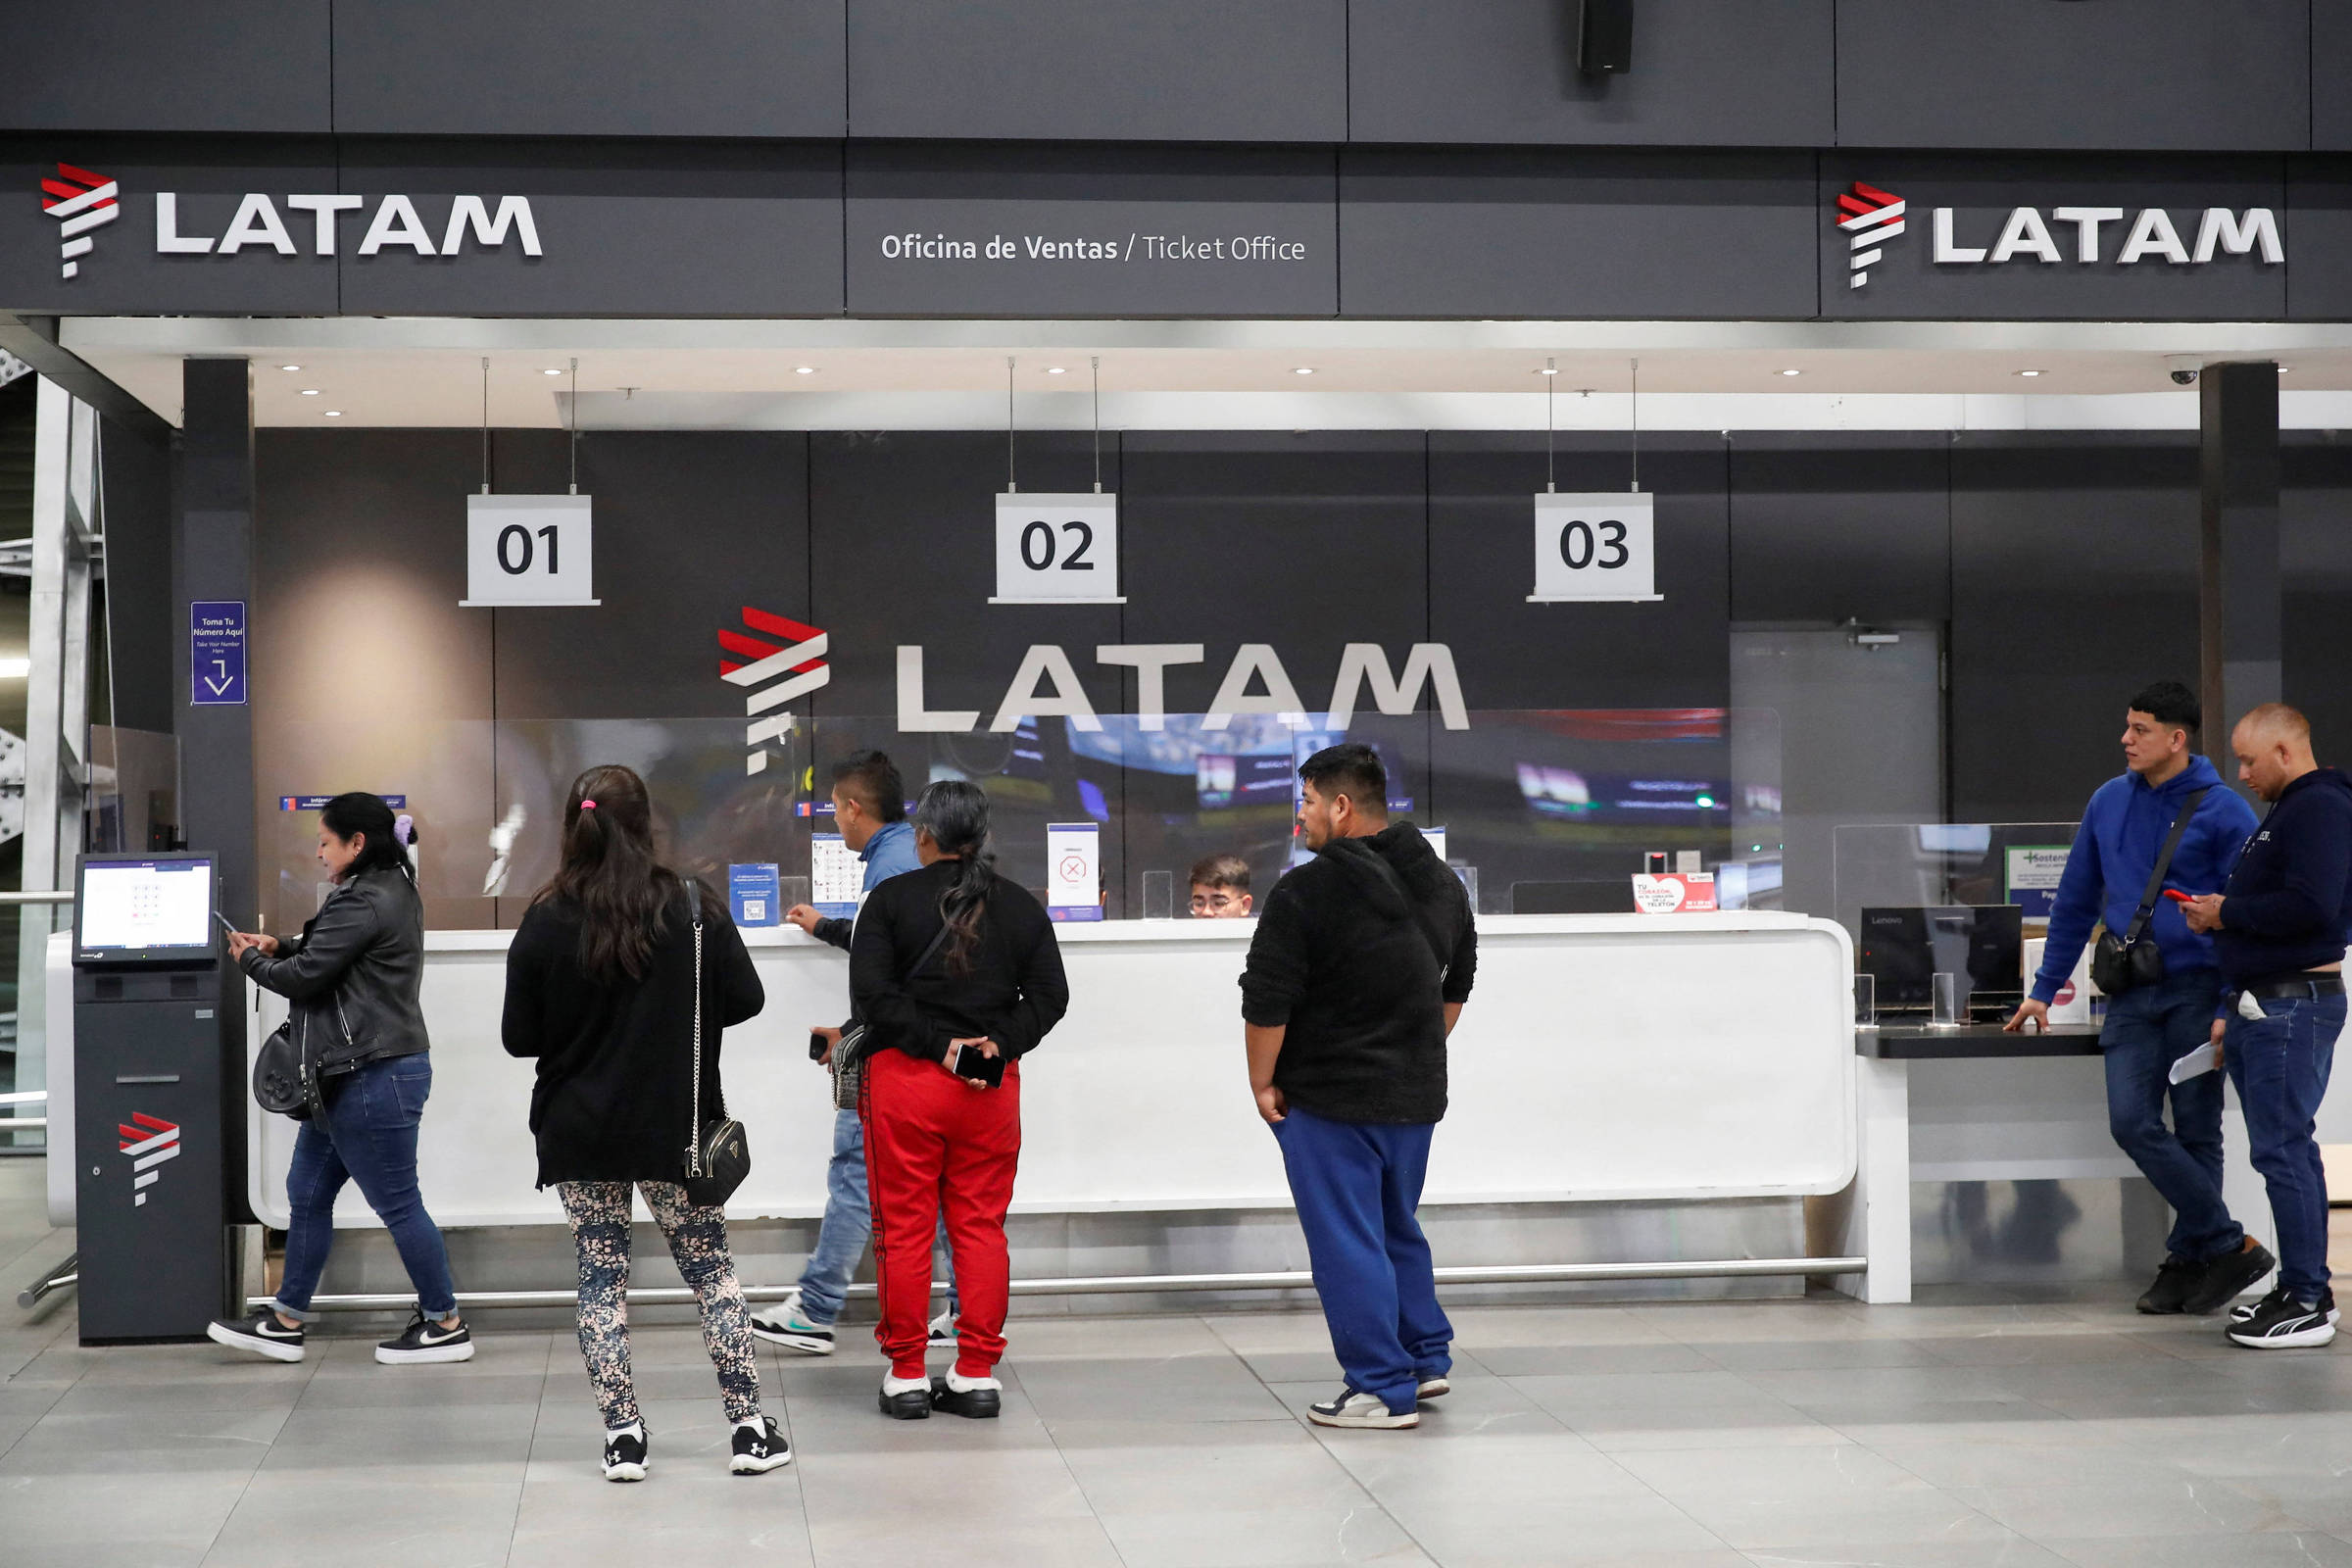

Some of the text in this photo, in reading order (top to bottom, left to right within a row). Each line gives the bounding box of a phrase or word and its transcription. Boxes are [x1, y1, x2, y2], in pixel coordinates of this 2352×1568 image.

[156, 191, 543, 257] LATAM
[881, 233, 977, 260] Oficina
[984, 234, 1017, 260] de
[1024, 235, 1118, 260] Ventas
[1143, 235, 1225, 261] Ticket
[1231, 236, 1306, 261] Office
[1932, 207, 2285, 264] LATAM
[497, 523, 559, 576] 01
[1020, 520, 1095, 571] 02
[1559, 519, 1630, 570] 03
[202, 617, 234, 626] Toma Tu
[225, 628, 243, 637] Aquí
[896, 643, 1471, 733] LATAM
[1872, 916, 1903, 925] Lenovo
